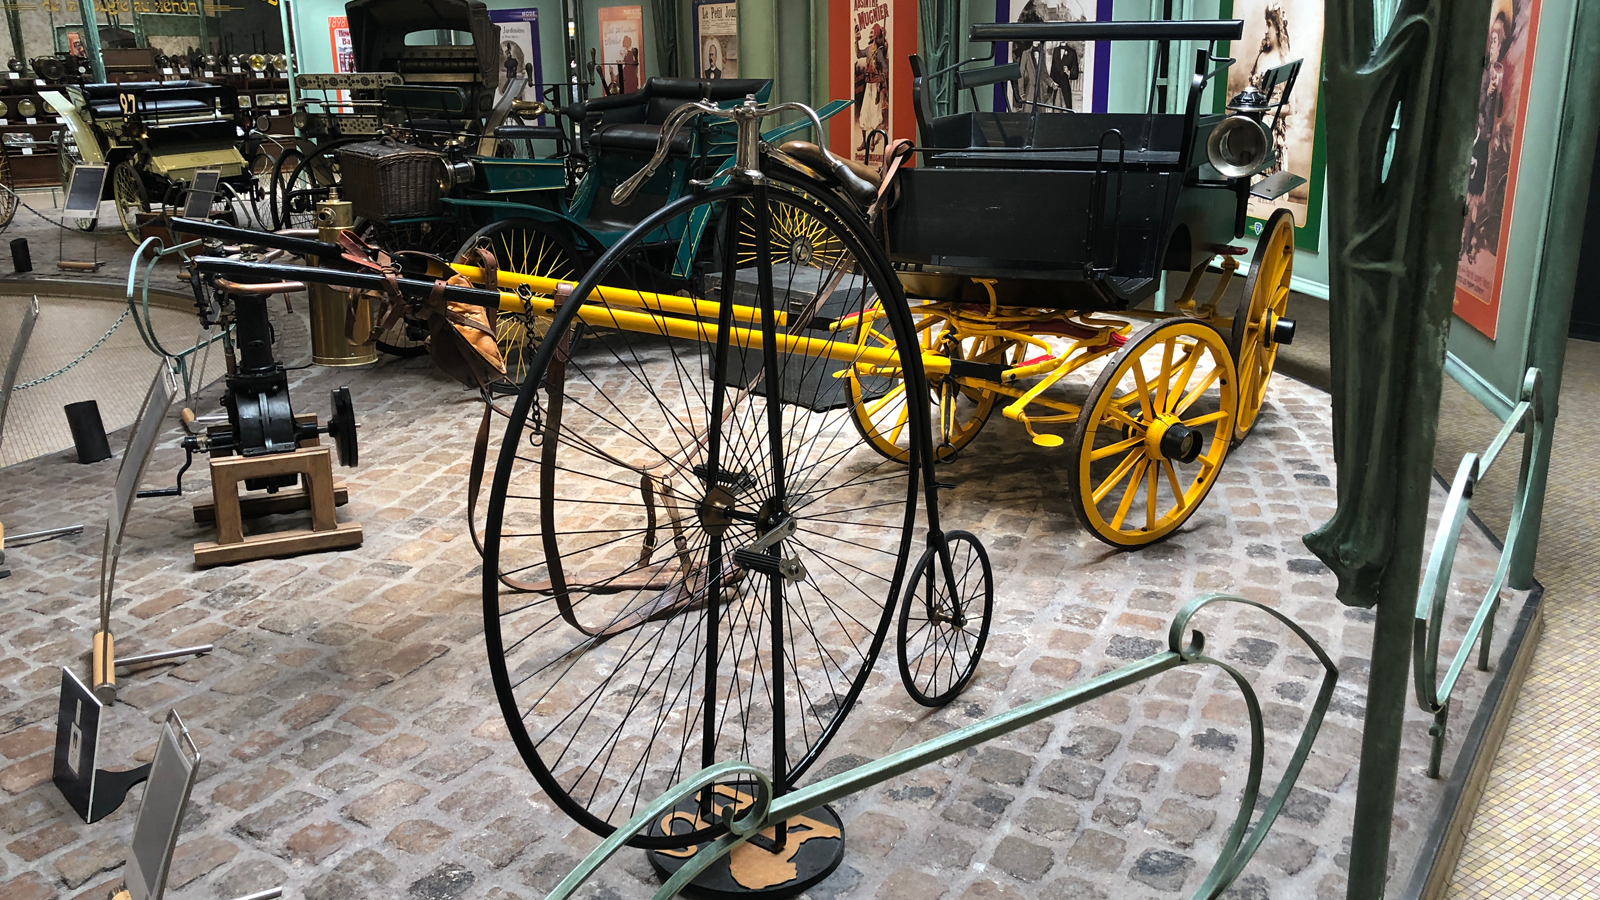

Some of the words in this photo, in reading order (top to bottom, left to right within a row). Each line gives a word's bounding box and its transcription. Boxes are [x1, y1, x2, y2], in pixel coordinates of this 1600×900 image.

[133, 1, 150, 12] au
[702, 7, 709, 19] Le
[710, 6, 723, 19] Petit
[328, 17, 346, 28] 1898
[857, 3, 889, 31] MUGNIER
[119, 92, 136, 120] 97
